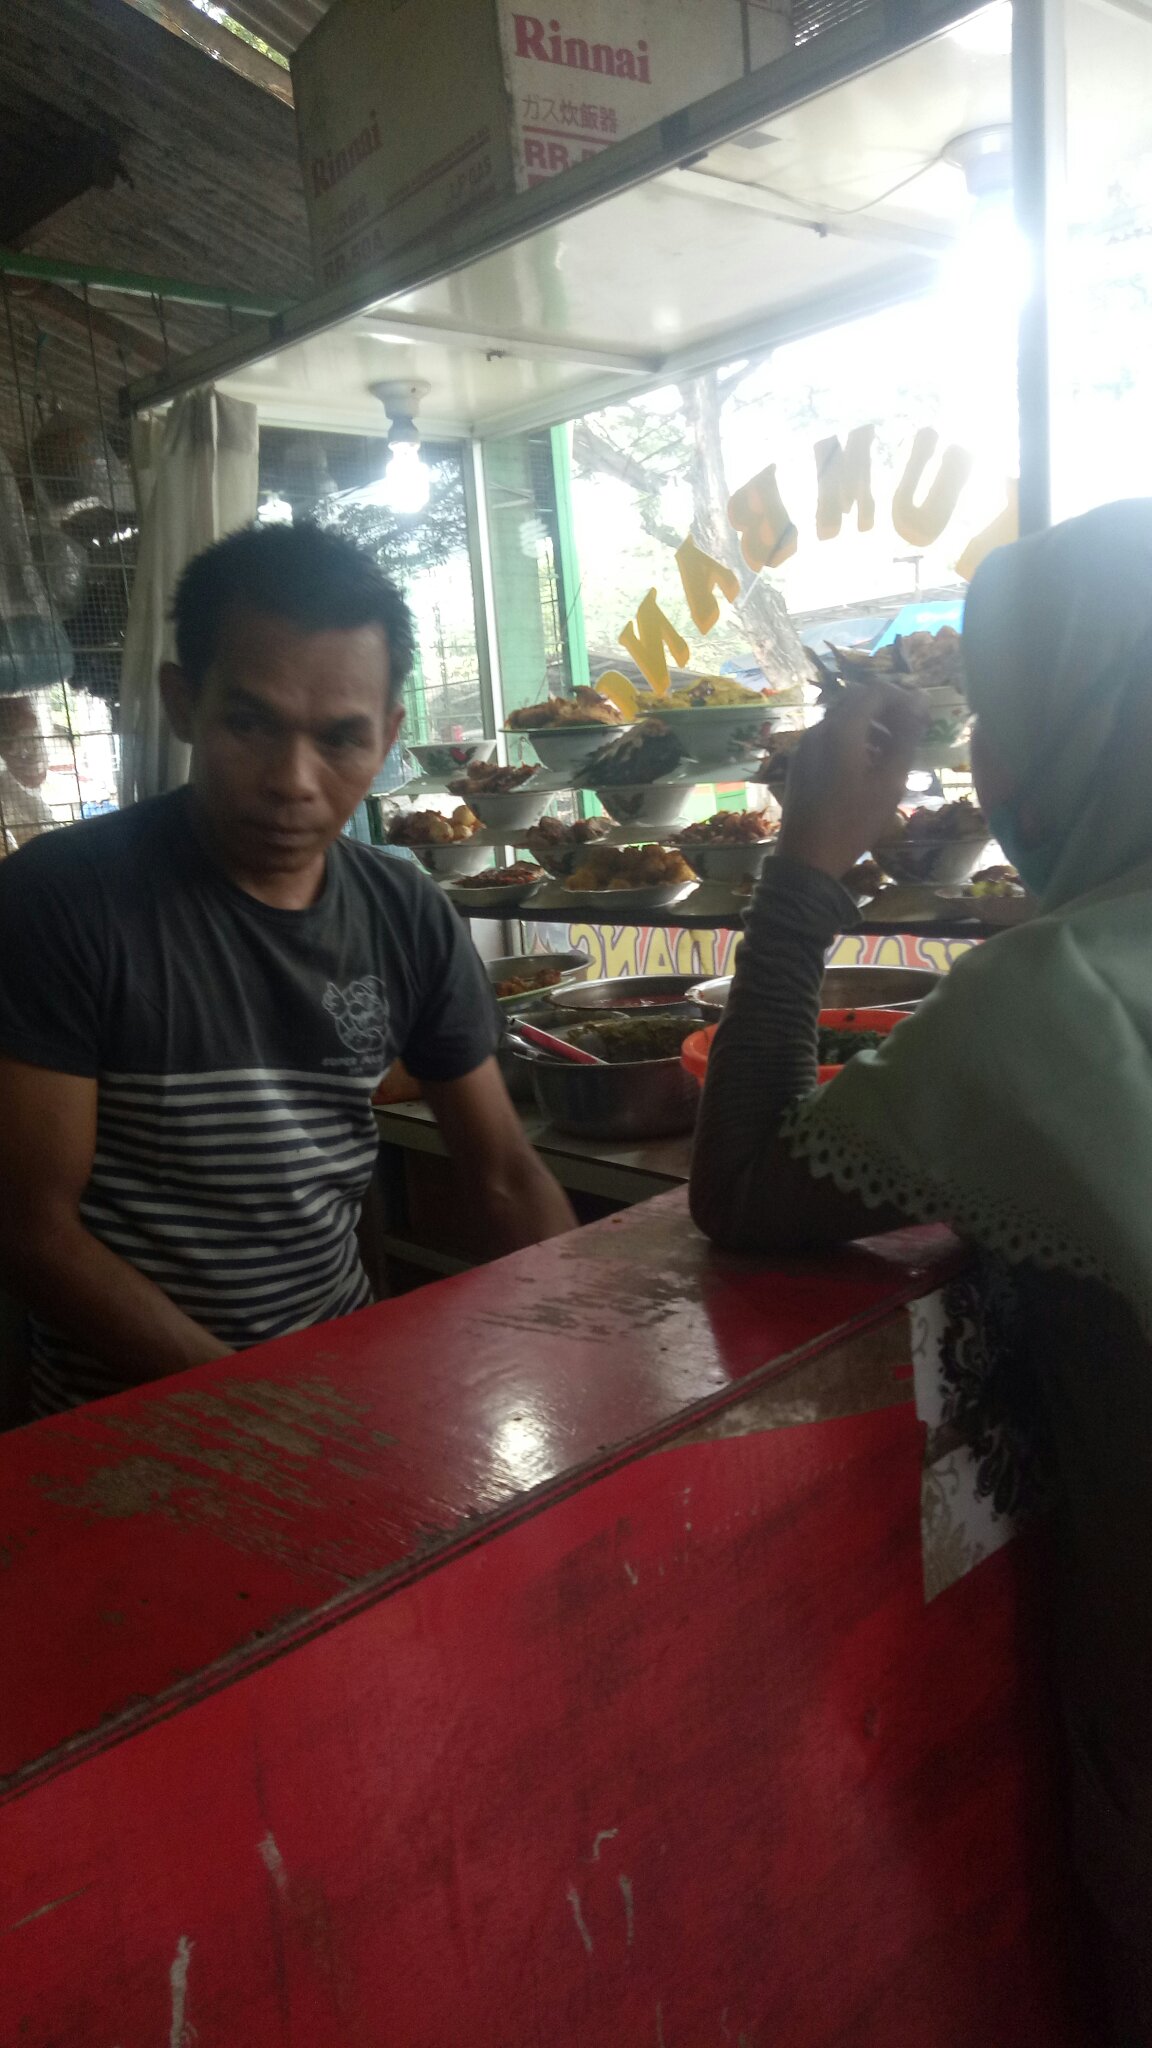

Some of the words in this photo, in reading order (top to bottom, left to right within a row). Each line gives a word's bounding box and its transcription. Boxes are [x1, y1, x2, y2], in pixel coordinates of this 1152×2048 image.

[512, 13, 652, 84] Rinnai
[522, 94, 617, 134] ガス炊飯器
[312, 109, 384, 198] Rinnai
